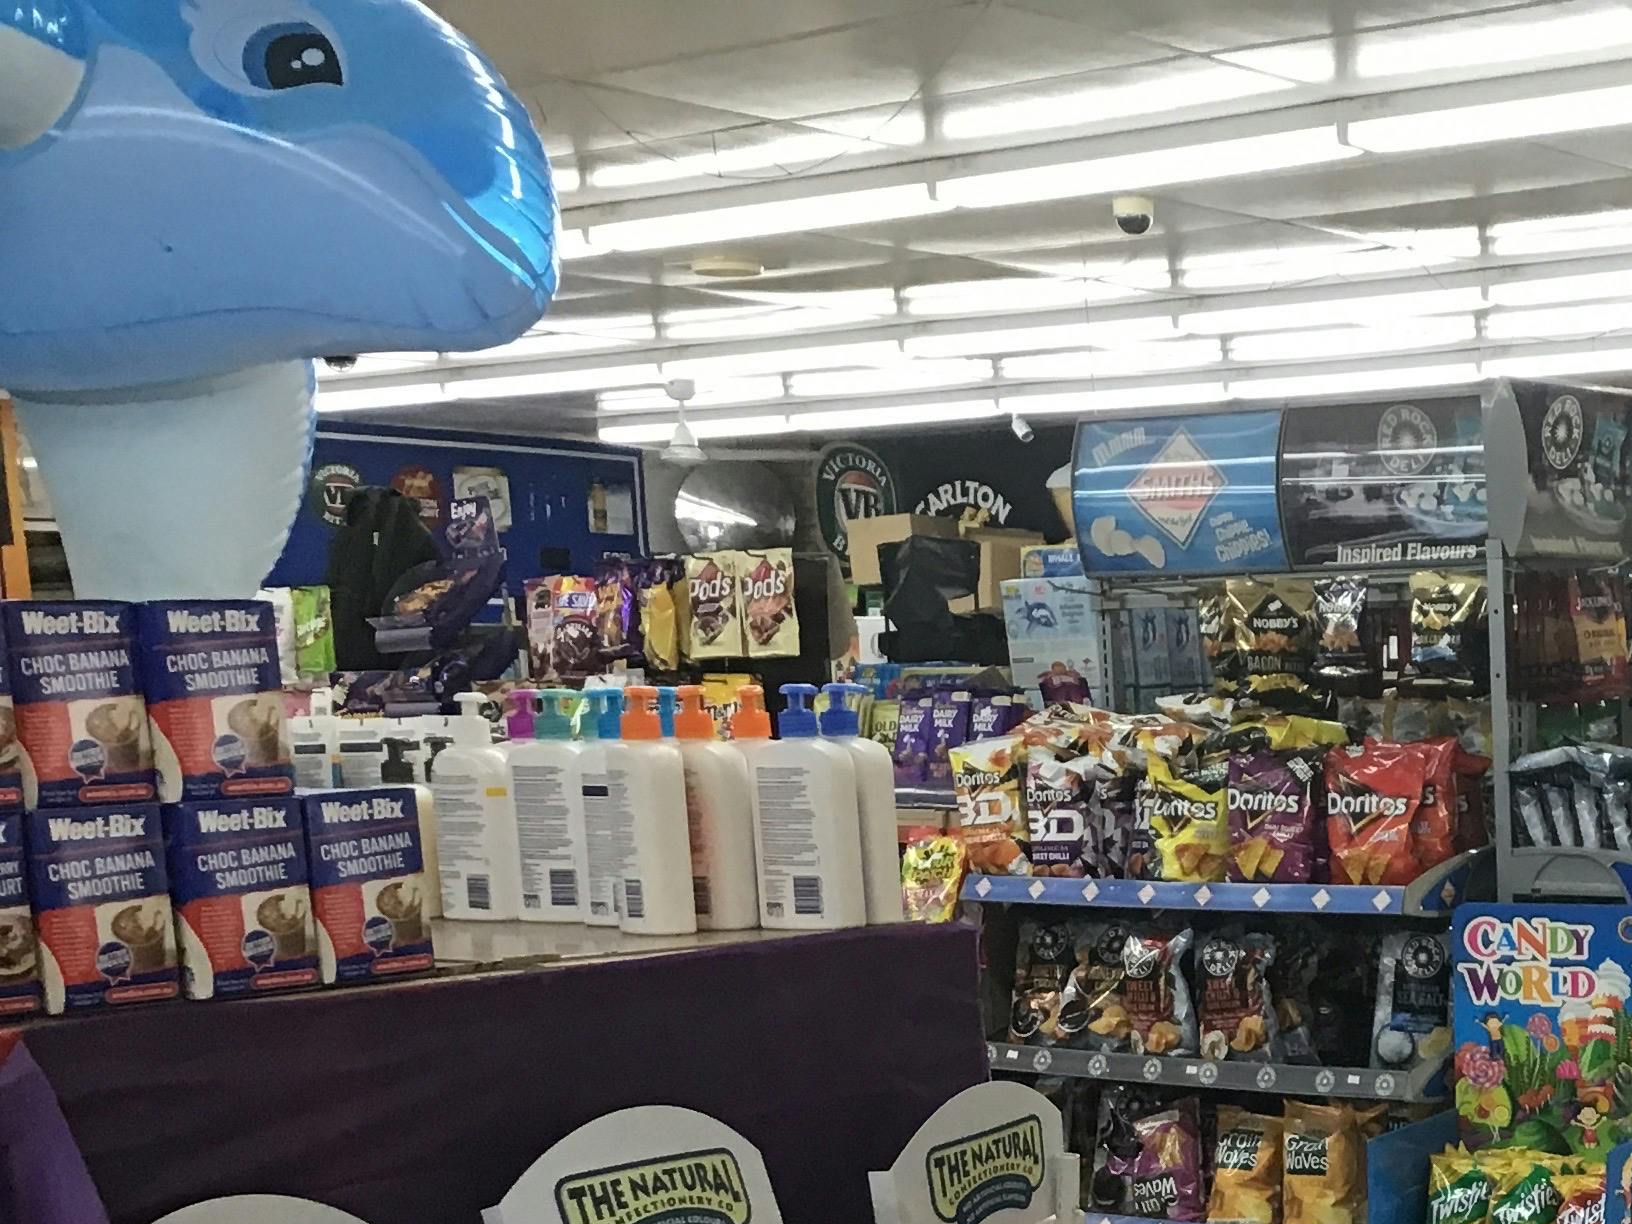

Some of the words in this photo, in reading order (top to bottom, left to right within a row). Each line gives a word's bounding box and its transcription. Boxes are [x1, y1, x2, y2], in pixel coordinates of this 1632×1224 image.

[1383, 413, 1400, 449] RED
[1401, 408, 1433, 445] ROCK
[1563, 399, 1581, 440] ROCK
[1389, 452, 1426, 473] DELI
[1550, 447, 1573, 466] DELI
[822, 452, 887, 488] VICTORIA
[915, 480, 1013, 525] CARLTON
[1337, 545, 1400, 565] Inspired
[1407, 542, 1477, 562] Flavours
[22, 610, 120, 635] Weet-Bix
[167, 609, 260, 633] Weet-Bix
[1253, 617, 1299, 629] NOBBY'S
[21, 658, 66, 676] CHOC
[69, 649, 129, 670] BANANA
[167, 654, 208, 672] CHOC
[211, 647, 269, 669] BANANA
[40, 673, 119, 694] SMOOTHIE
[184, 670, 259, 691] SMOOTHIE
[900, 713, 925, 723] DAIRY
[933, 709, 958, 720] DAIRY
[935, 718, 954, 729] MILK
[973, 713, 998, 724] DAIRY
[973, 721, 994, 732] MILK
[900, 722, 920, 733] MILK
[956, 772, 1000, 787] Doritos
[1027, 787, 1072, 803] Doritos
[1228, 789, 1299, 813] Doritos
[1327, 791, 1408, 816] Doritos
[198, 807, 287, 832] Weet-Bix
[321, 800, 404, 823] Weet-Bix
[49, 815, 145, 841] Weet-Bix
[1027, 809, 1084, 842] 3D
[198, 855, 239, 873] CHOC
[242, 843, 296, 868] BANANA
[320, 844, 359, 861] CHOC
[362, 832, 412, 856] BANANA
[48, 864, 92, 883] CHOC
[95, 850, 155, 876] BANANA
[215, 866, 288, 890] SMOOTHIE
[337, 854, 404, 878] SMOOTHIE
[68, 876, 145, 900] SMOOTHIE
[1464, 916, 1594, 961] CANDY
[1457, 962, 1601, 1007] WORLD
[934, 1150, 970, 1198] THE
[970, 1125, 1039, 1170] NATURAL
[1284, 1151, 1330, 1172] Waves
[628, 1159, 742, 1203] NATURAL
